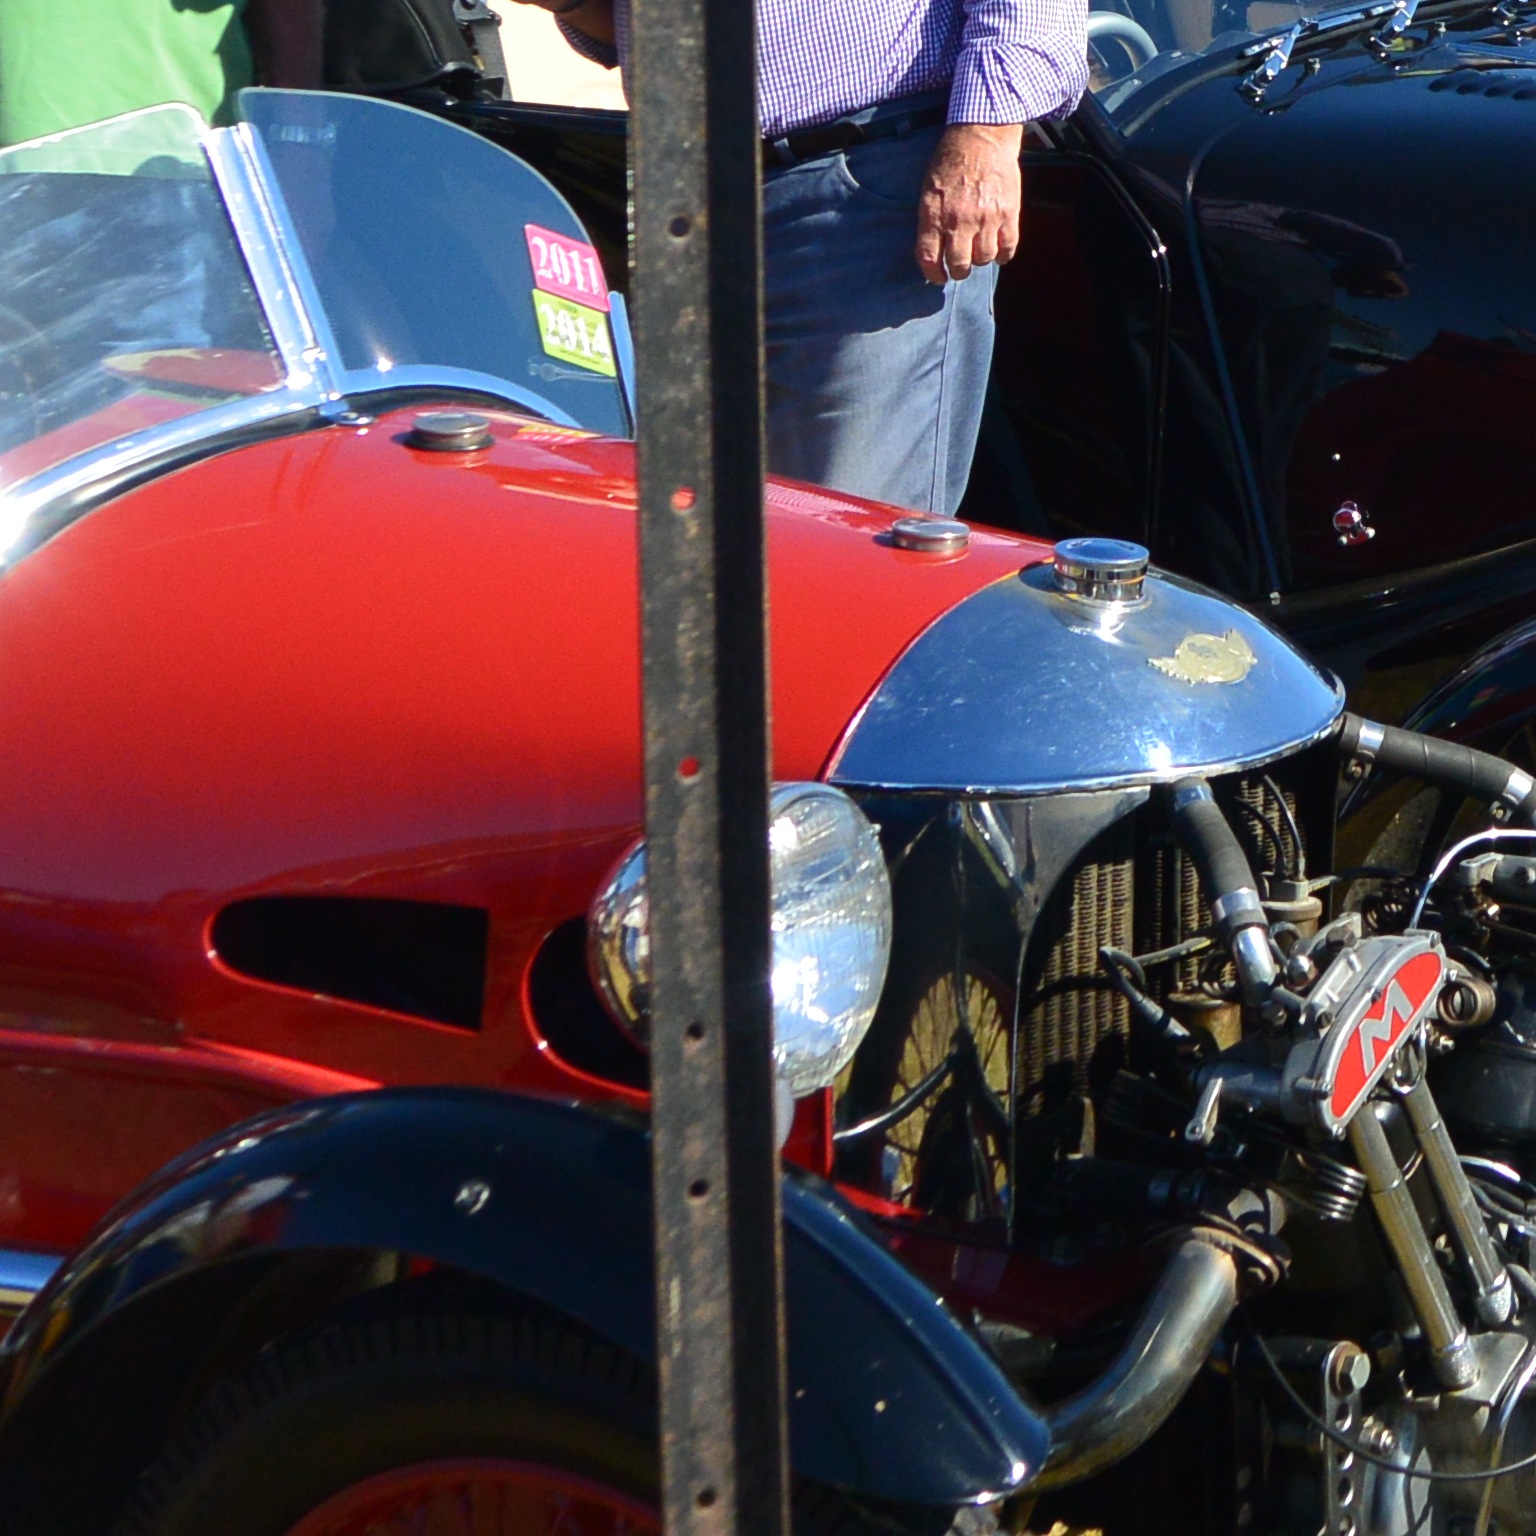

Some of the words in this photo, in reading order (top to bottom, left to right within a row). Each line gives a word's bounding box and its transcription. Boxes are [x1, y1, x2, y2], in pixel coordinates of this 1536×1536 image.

[531, 235, 599, 295] 2011
[538, 303, 611, 364] 2014
[1358, 978, 1415, 1077] M
